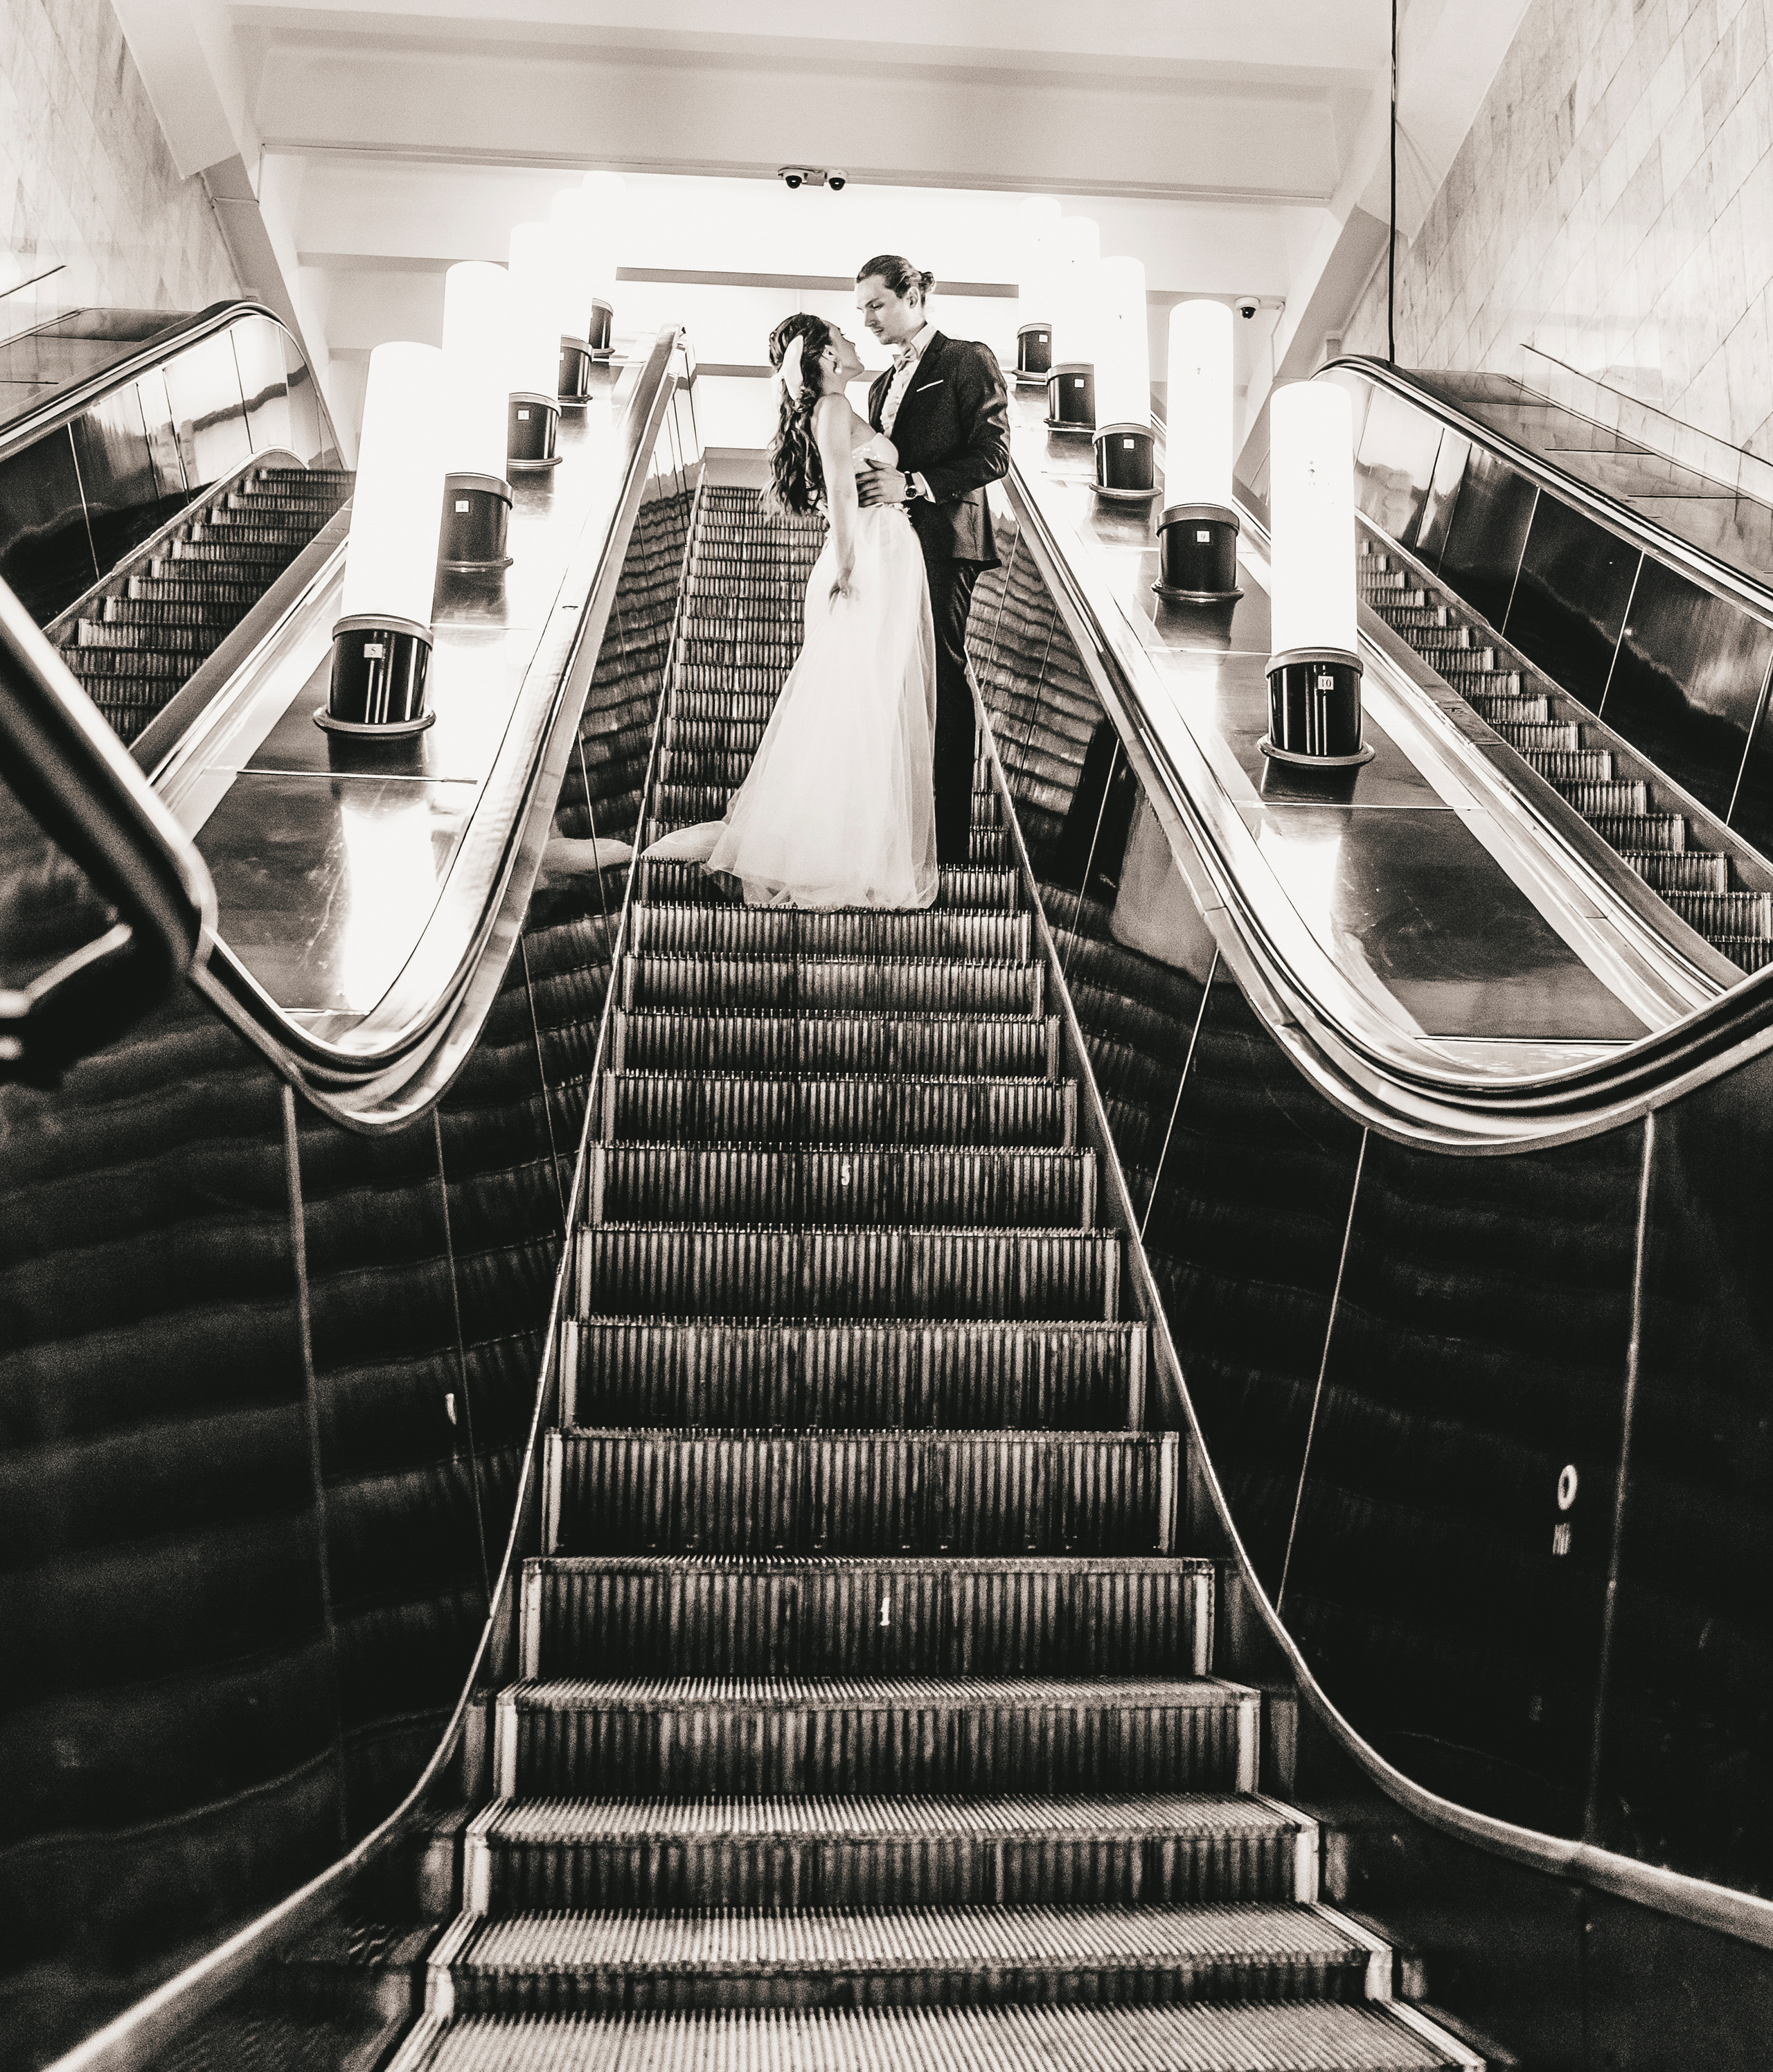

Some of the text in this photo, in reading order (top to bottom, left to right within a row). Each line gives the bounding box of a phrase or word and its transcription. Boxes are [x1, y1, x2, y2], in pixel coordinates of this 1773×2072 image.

[1321, 679, 1332, 688] 10
[841, 1164, 851, 1186] 5
[880, 1596, 891, 1626] 1
